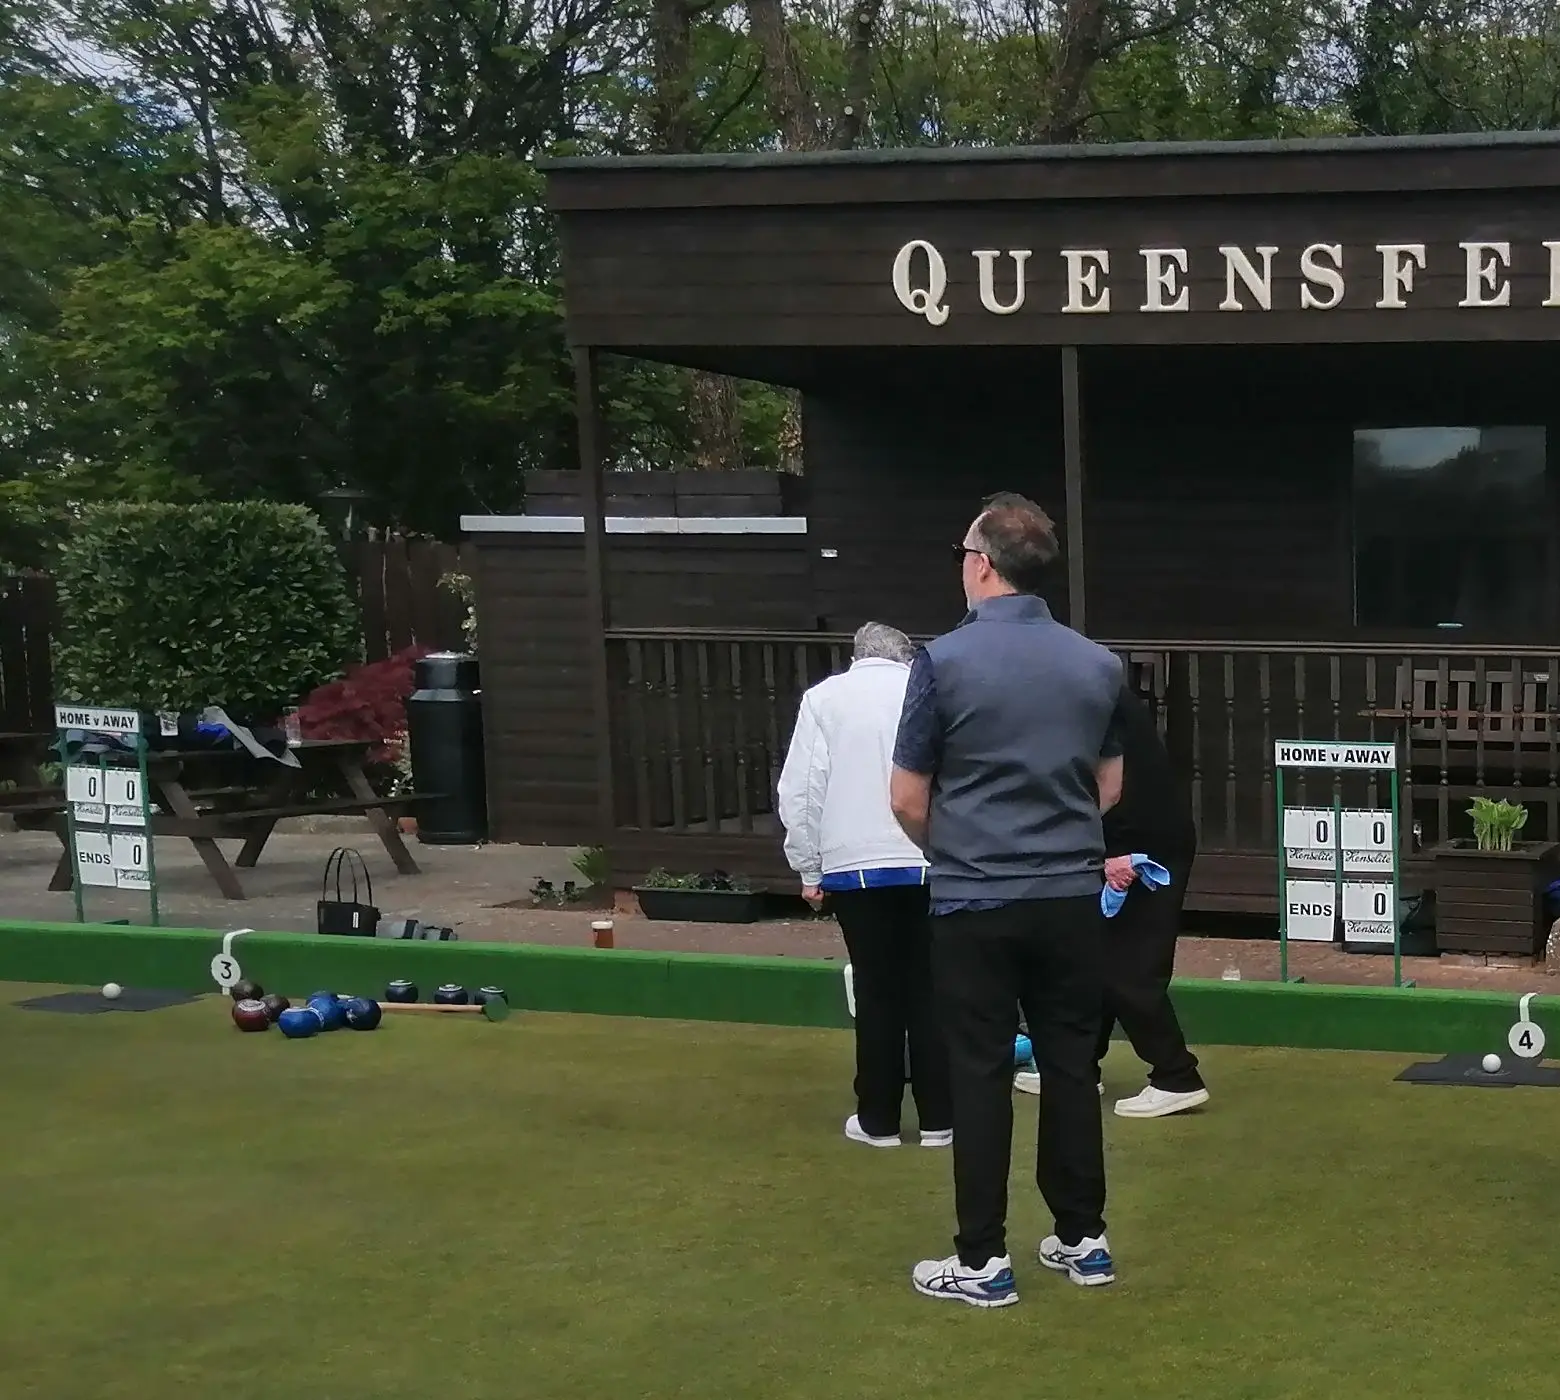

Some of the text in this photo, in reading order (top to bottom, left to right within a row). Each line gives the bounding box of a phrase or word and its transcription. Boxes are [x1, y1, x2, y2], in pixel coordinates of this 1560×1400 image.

[59, 711, 90, 726] HOME
[103, 715, 135, 729] AWAY
[1280, 748, 1327, 762] HOME
[1344, 749, 1391, 764] AWAY
[88, 776, 97, 798] 0
[126, 779, 135, 801] 0
[1315, 819, 1329, 843] 0
[1372, 821, 1386, 845] 0
[79, 851, 111, 865] ENDS
[133, 844, 142, 866] 0
[1289, 847, 1334, 862] Henselite
[1345, 849, 1391, 864] Henselite
[1289, 902, 1333, 917] ENDS
[1374, 892, 1387, 916] 0
[1347, 920, 1392, 935] Henselite
[220, 960, 232, 980] 3
[1518, 1029, 1534, 1050] 4
